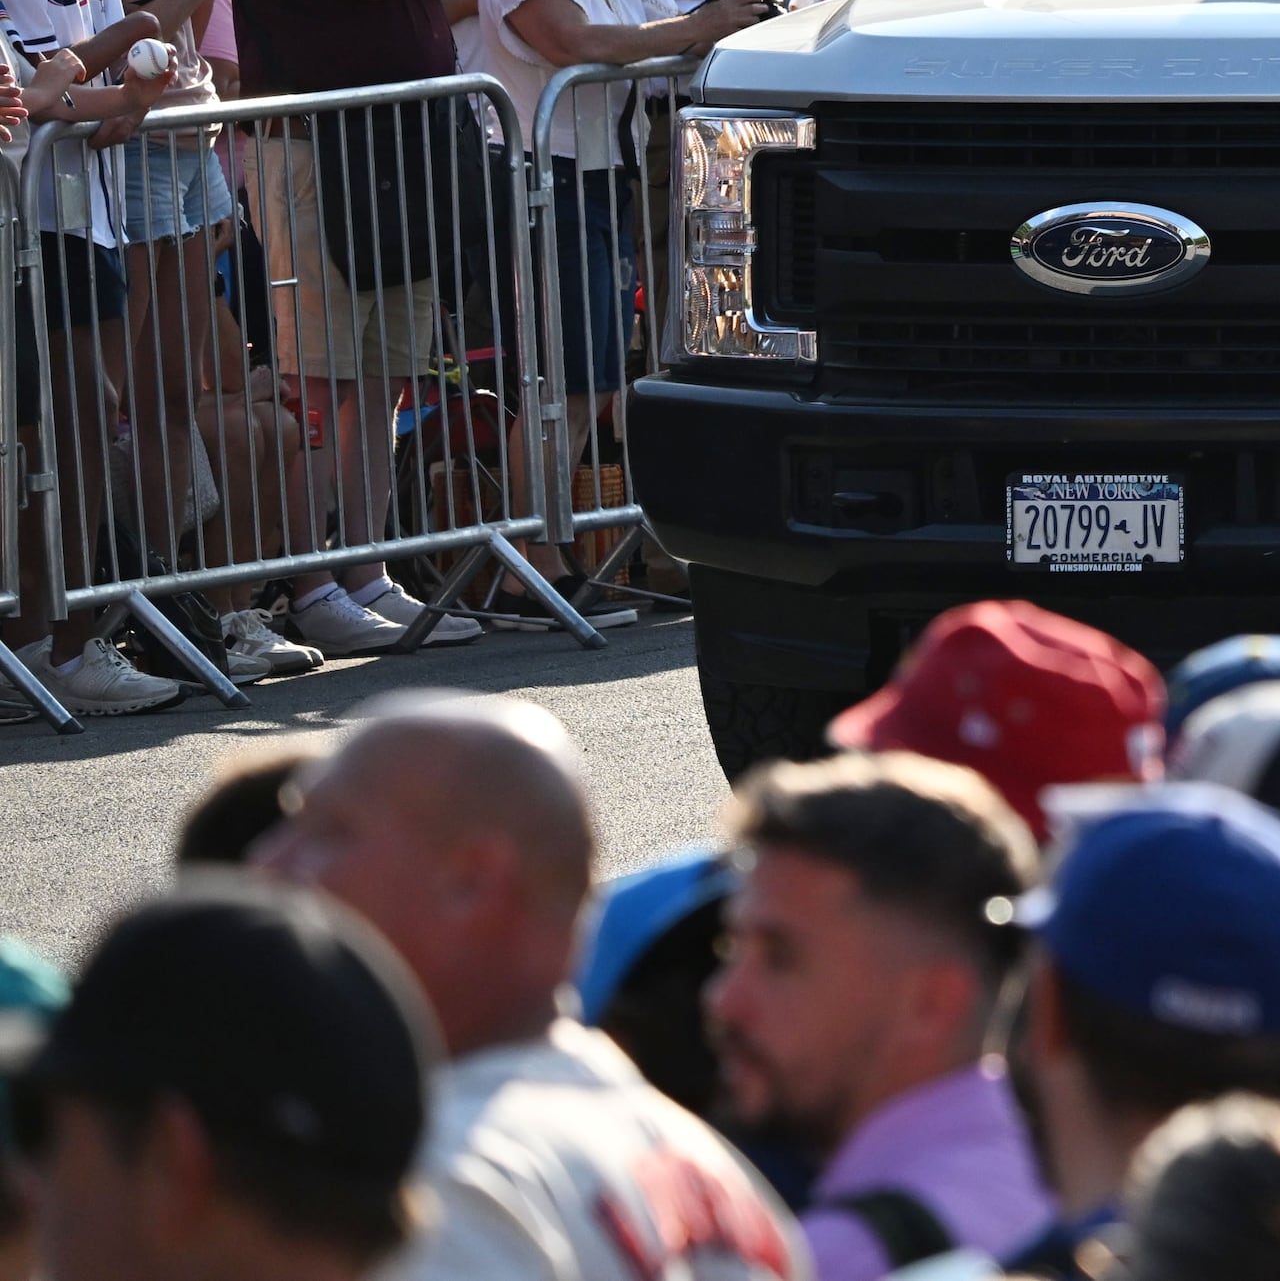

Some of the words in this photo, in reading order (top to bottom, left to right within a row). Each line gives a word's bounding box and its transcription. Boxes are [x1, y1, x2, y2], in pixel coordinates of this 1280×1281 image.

[904, 57, 1143, 80] SUPER
[1061, 226, 1152, 269] Ford
[1022, 475, 1069, 483] ROYAL
[1075, 475, 1169, 483] AUTOMOTIVE
[1052, 484, 1090, 499] NEW
[1095, 484, 1141, 500] YORK
[1024, 504, 1110, 550] 20799
[1134, 504, 1166, 550] JV
[1051, 553, 1142, 562] COMMERCIAL
[1050, 564, 1142, 572] KEVINSROYALAUTO.COM
